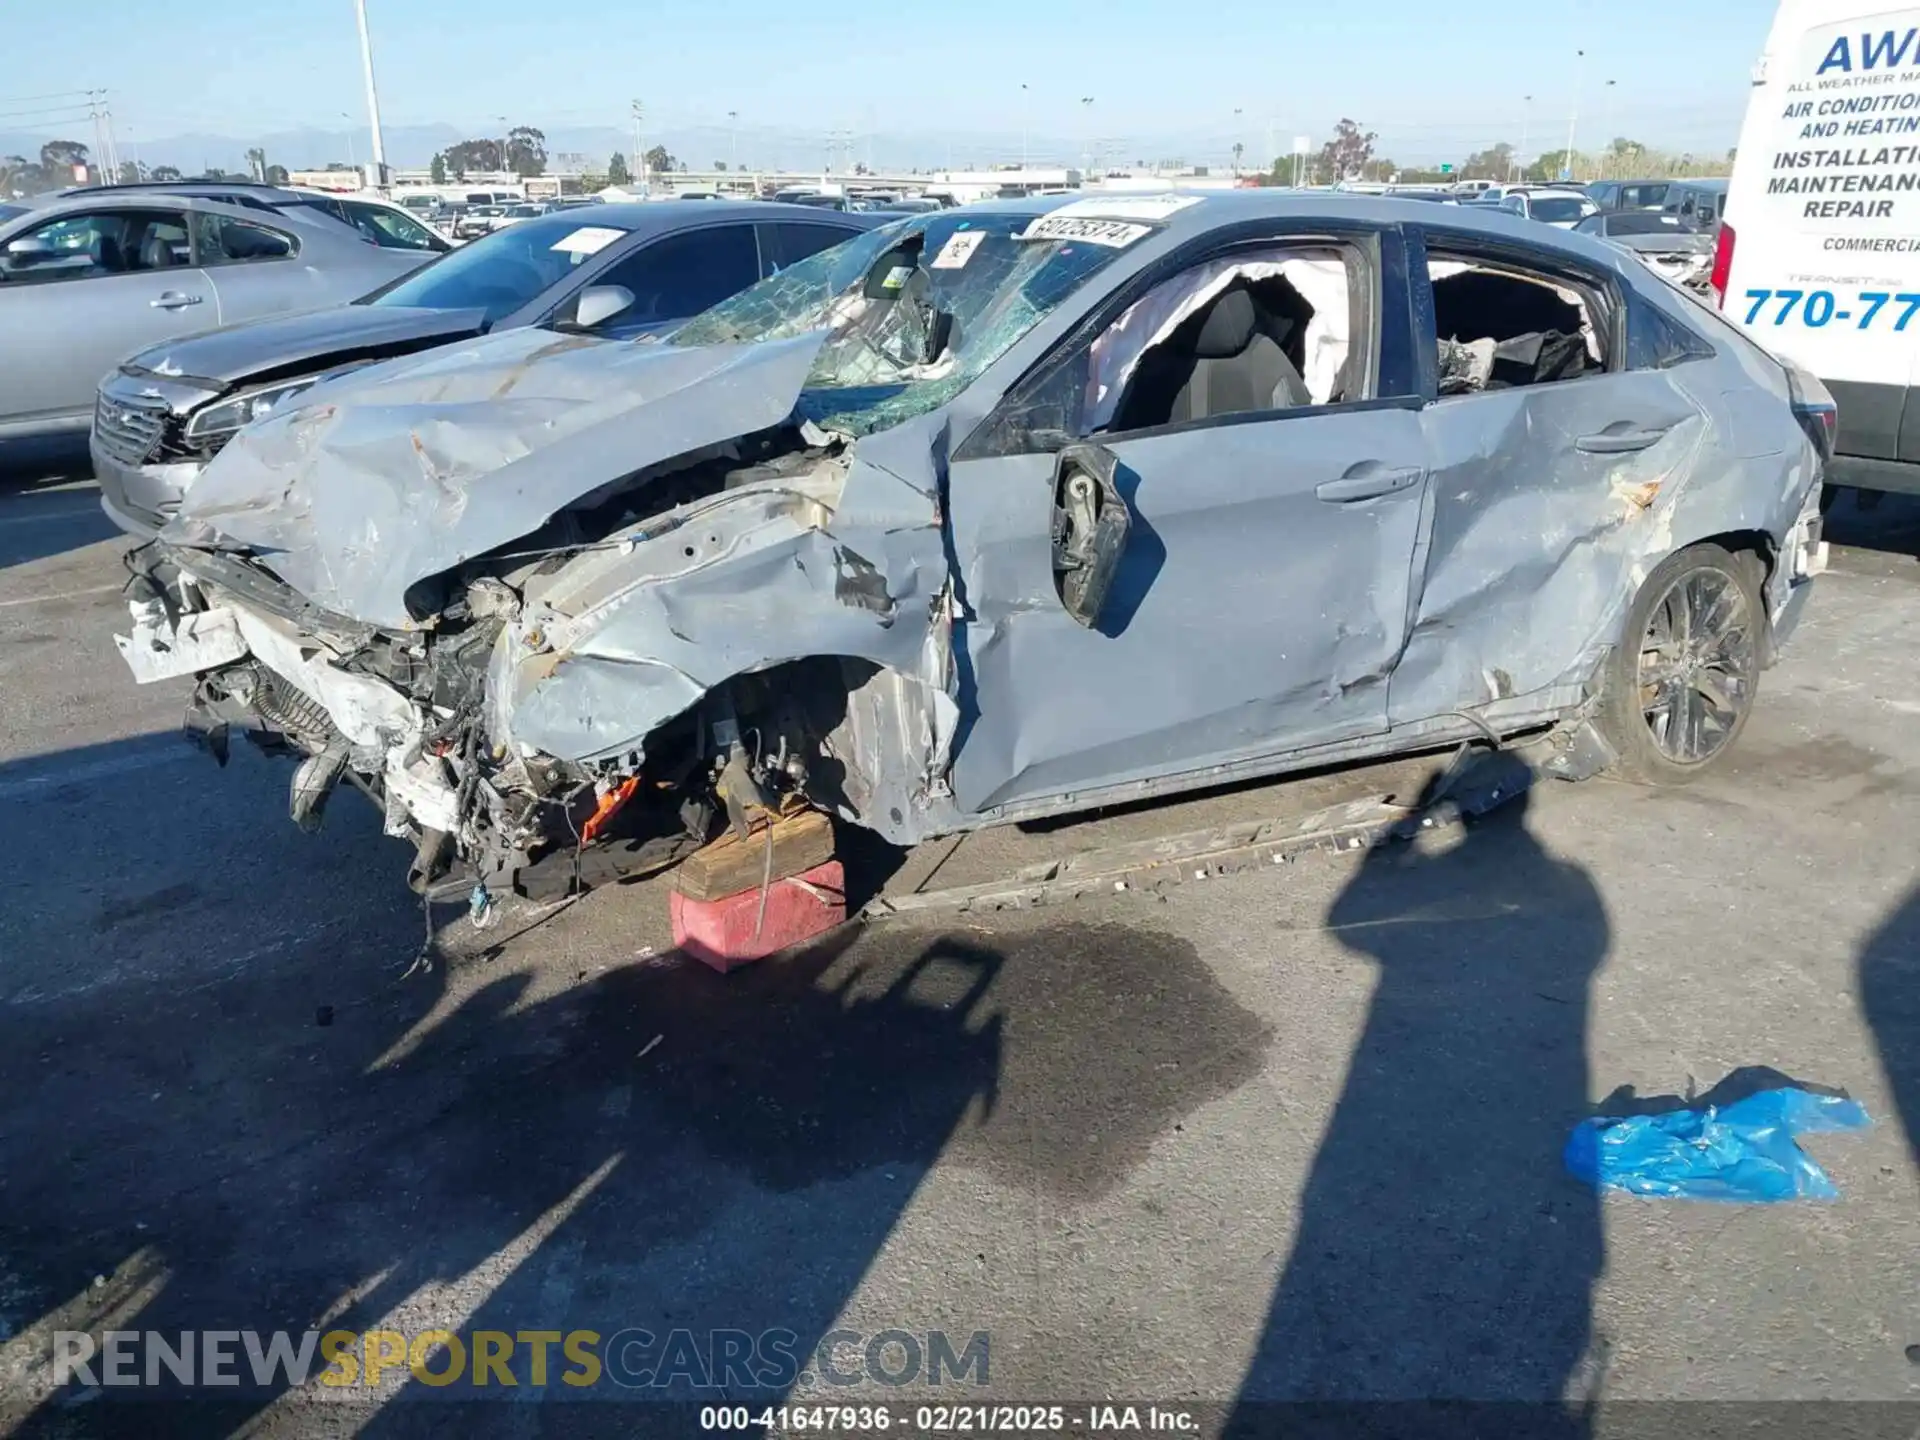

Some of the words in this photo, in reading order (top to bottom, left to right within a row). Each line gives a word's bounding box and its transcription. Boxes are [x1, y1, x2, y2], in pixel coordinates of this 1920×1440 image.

[1816, 28, 1920, 75] AW
[1787, 82, 1813, 93] ALL
[1818, 74, 1895, 89] WEATHER
[1782, 102, 1813, 118] AIR
[1799, 122, 1839, 138] AND
[1773, 146, 1920, 169] INSTALLATI
[1767, 173, 1920, 194] MAINTENAN
[1803, 200, 1894, 218] REPAIR
